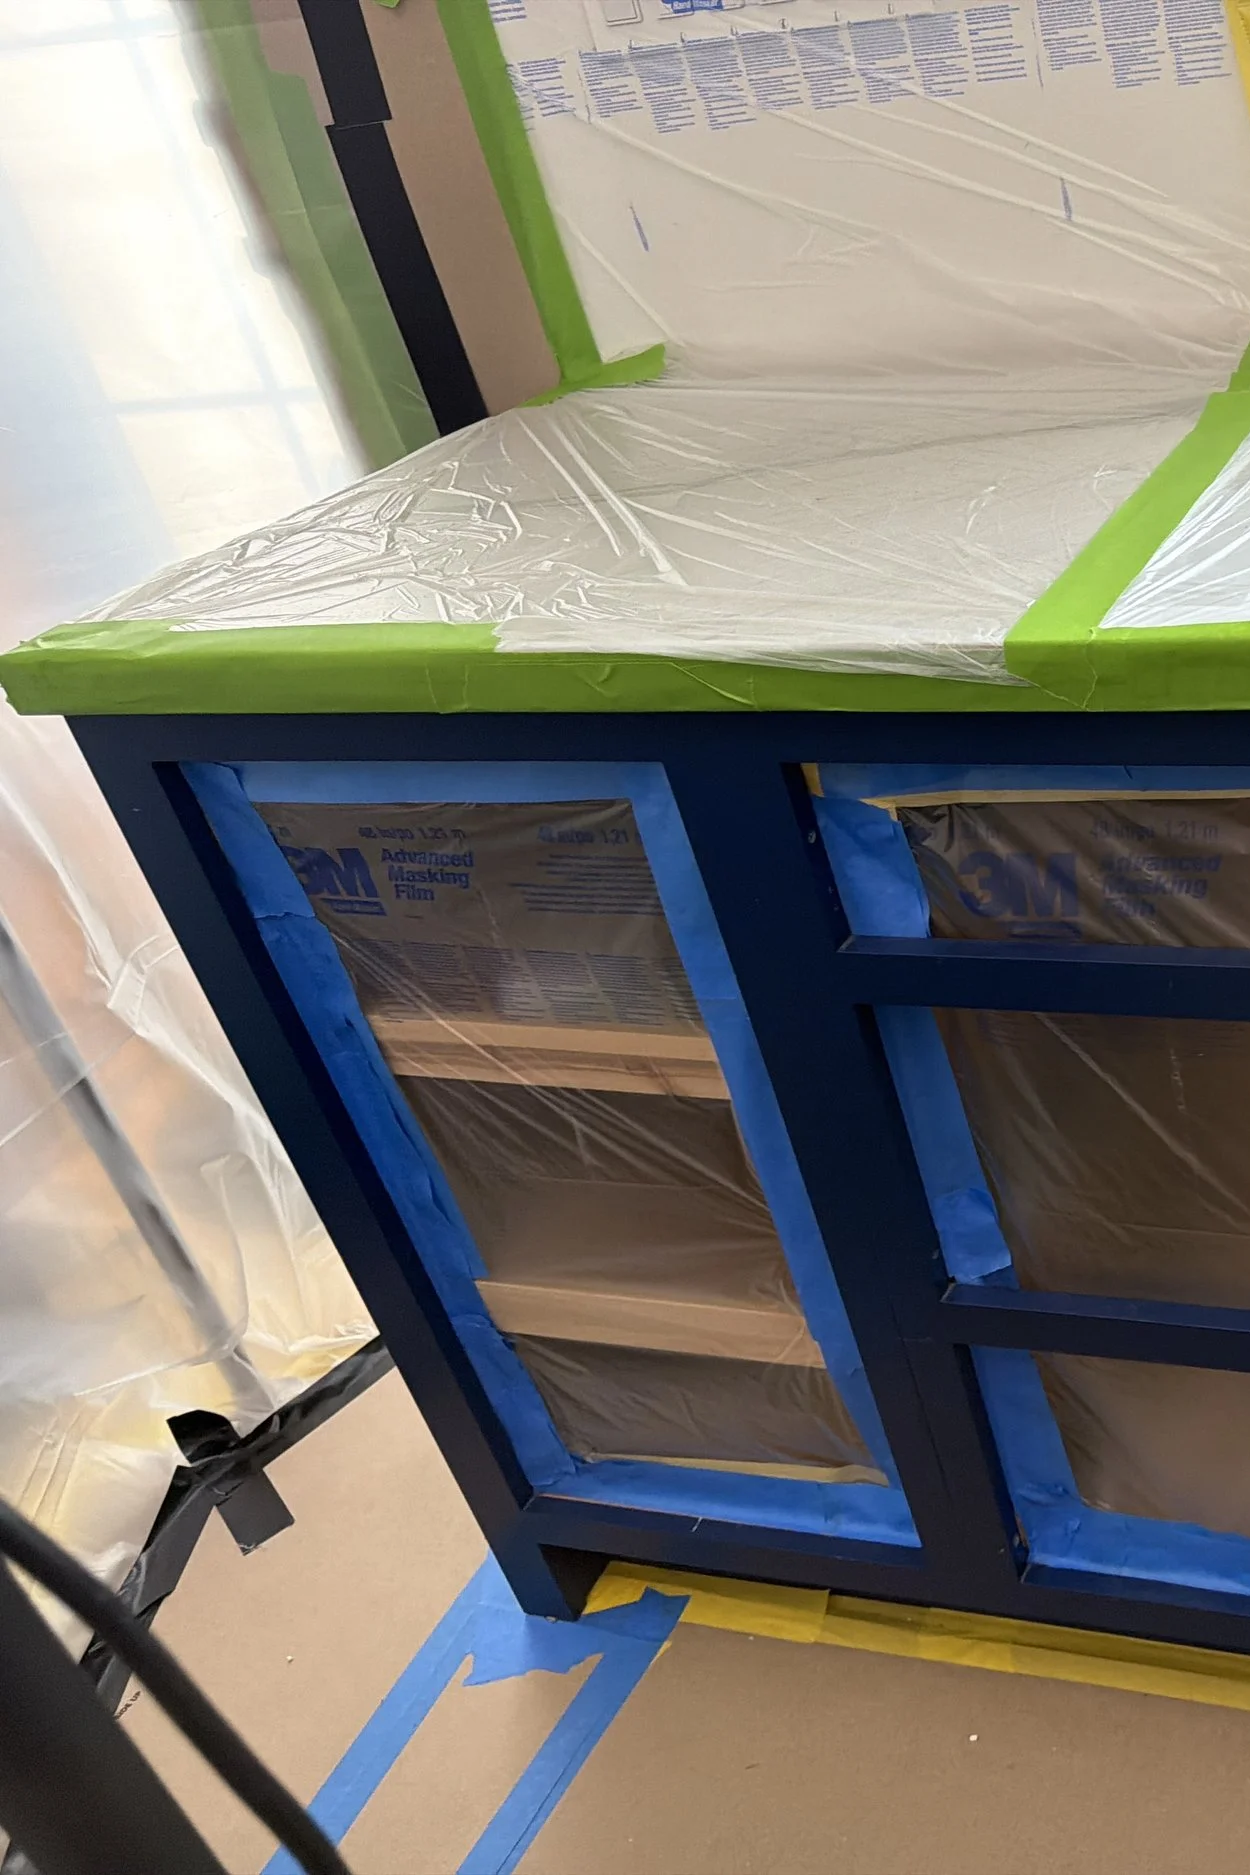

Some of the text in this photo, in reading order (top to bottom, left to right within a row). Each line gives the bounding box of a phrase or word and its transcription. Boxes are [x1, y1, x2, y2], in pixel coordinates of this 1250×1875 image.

[381, 848, 474, 867] Advanced
[387, 865, 470, 889] Masking
[957, 852, 1080, 918] 3M
[394, 882, 435, 901] Film
